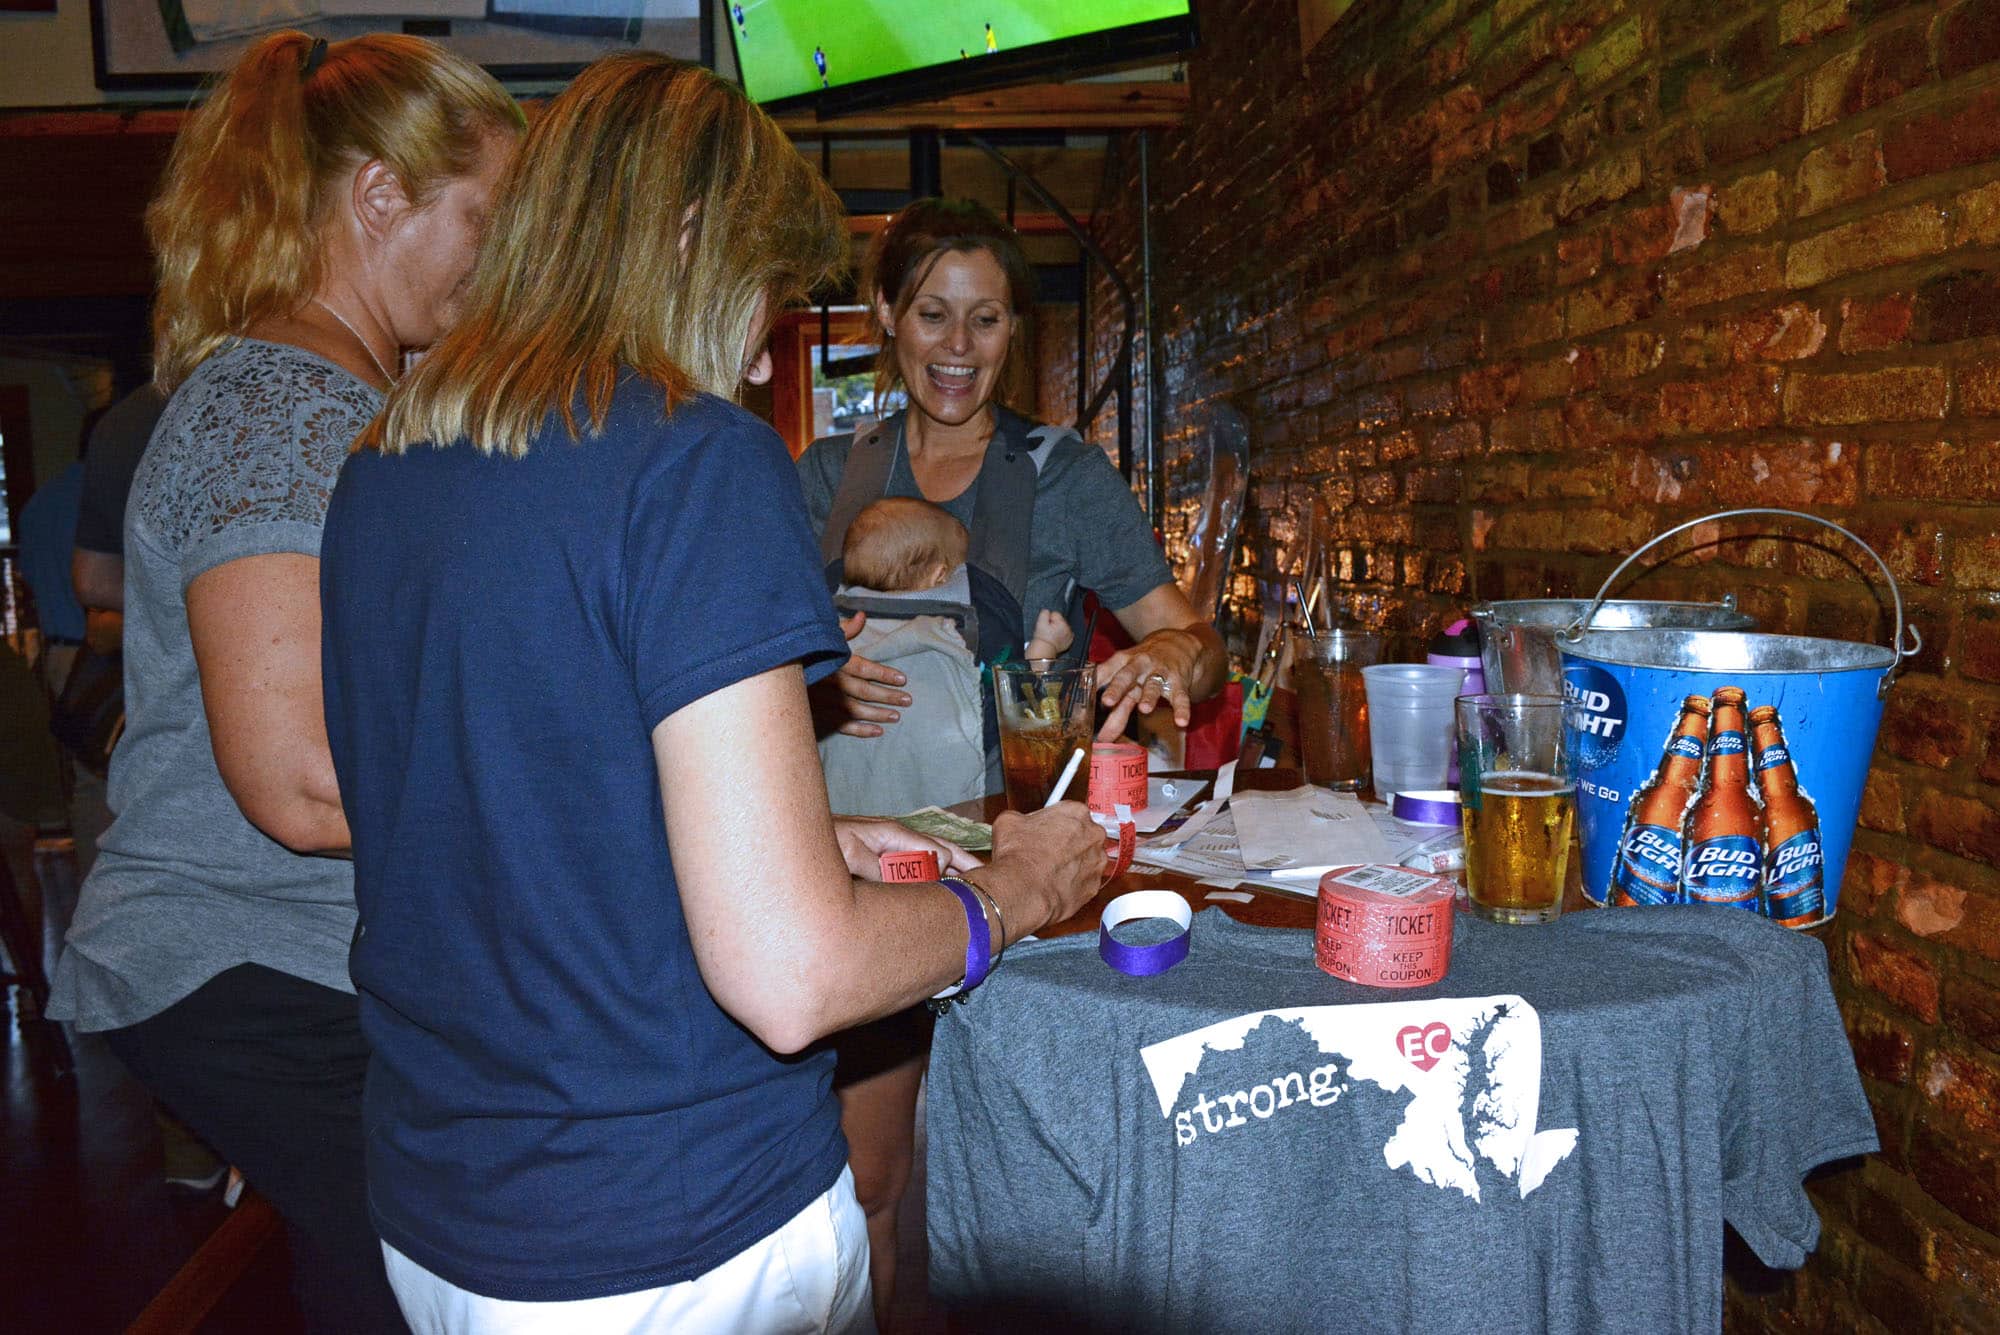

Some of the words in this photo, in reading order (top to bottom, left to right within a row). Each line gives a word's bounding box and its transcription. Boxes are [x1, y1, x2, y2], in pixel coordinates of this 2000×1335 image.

[1677, 738, 1700, 751] BUD
[1710, 741, 1744, 751] LIGHT
[1715, 736, 1742, 744] BUD
[1671, 743, 1700, 756] LIGHT
[1763, 749, 1785, 759] BUD
[1760, 754, 1788, 766] LIGHT
[1581, 780, 1596, 795] WE
[1598, 786, 1620, 803] GO
[1636, 830, 1682, 861] BUD
[1626, 840, 1681, 876] LIGHT
[1699, 847, 1756, 864] BUD
[1775, 842, 1818, 867] BUD
[888, 861, 923, 881] TICKET
[1686, 863, 1760, 880] LIGHT
[1767, 854, 1822, 885] LIGHT
[1385, 914, 1433, 936] TICKET
[1393, 952, 1424, 963] KEEP
[1379, 968, 1432, 981] COUPON
[1401, 1028, 1447, 1062] EC
